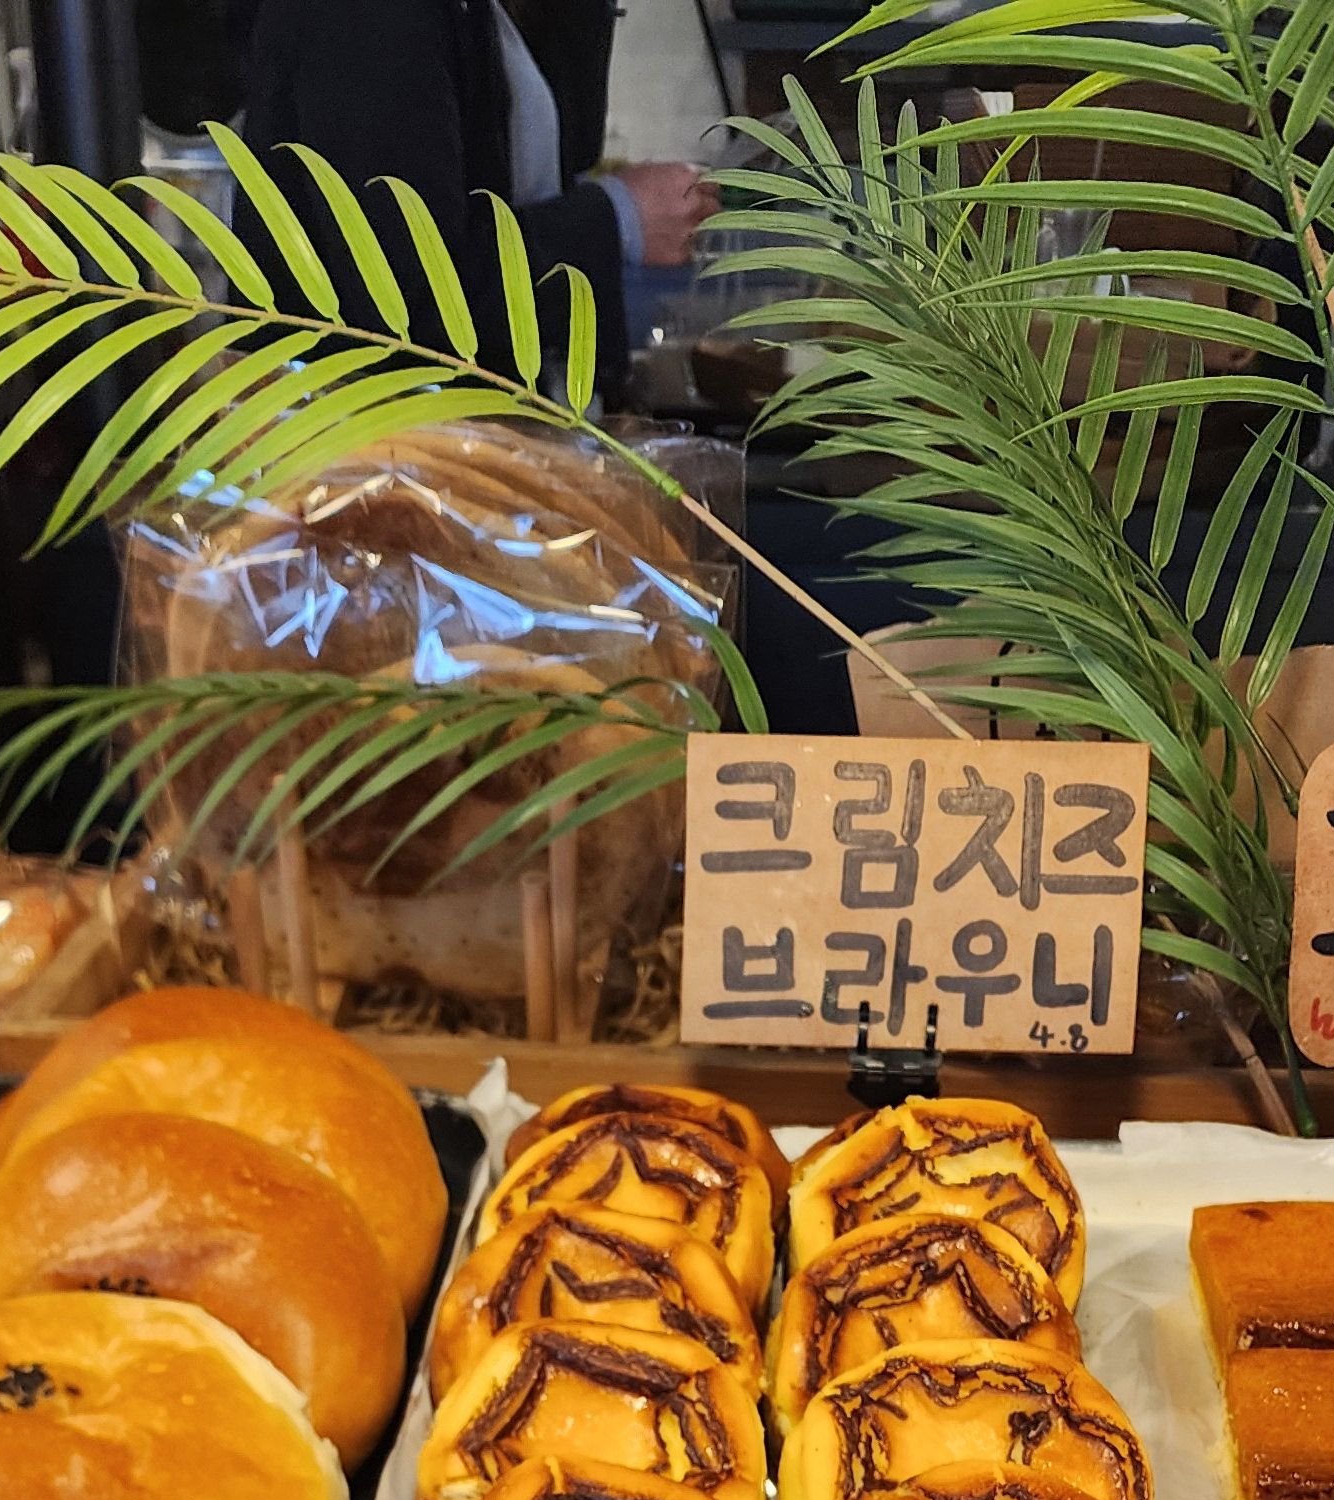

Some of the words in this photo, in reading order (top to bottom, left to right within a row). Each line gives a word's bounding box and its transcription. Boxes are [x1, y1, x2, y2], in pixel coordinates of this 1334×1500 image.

[699, 757, 1140, 912] 크림치즈
[701, 917, 1114, 1036] 브라우니
[1027, 1020, 1091, 1053] 4.8
